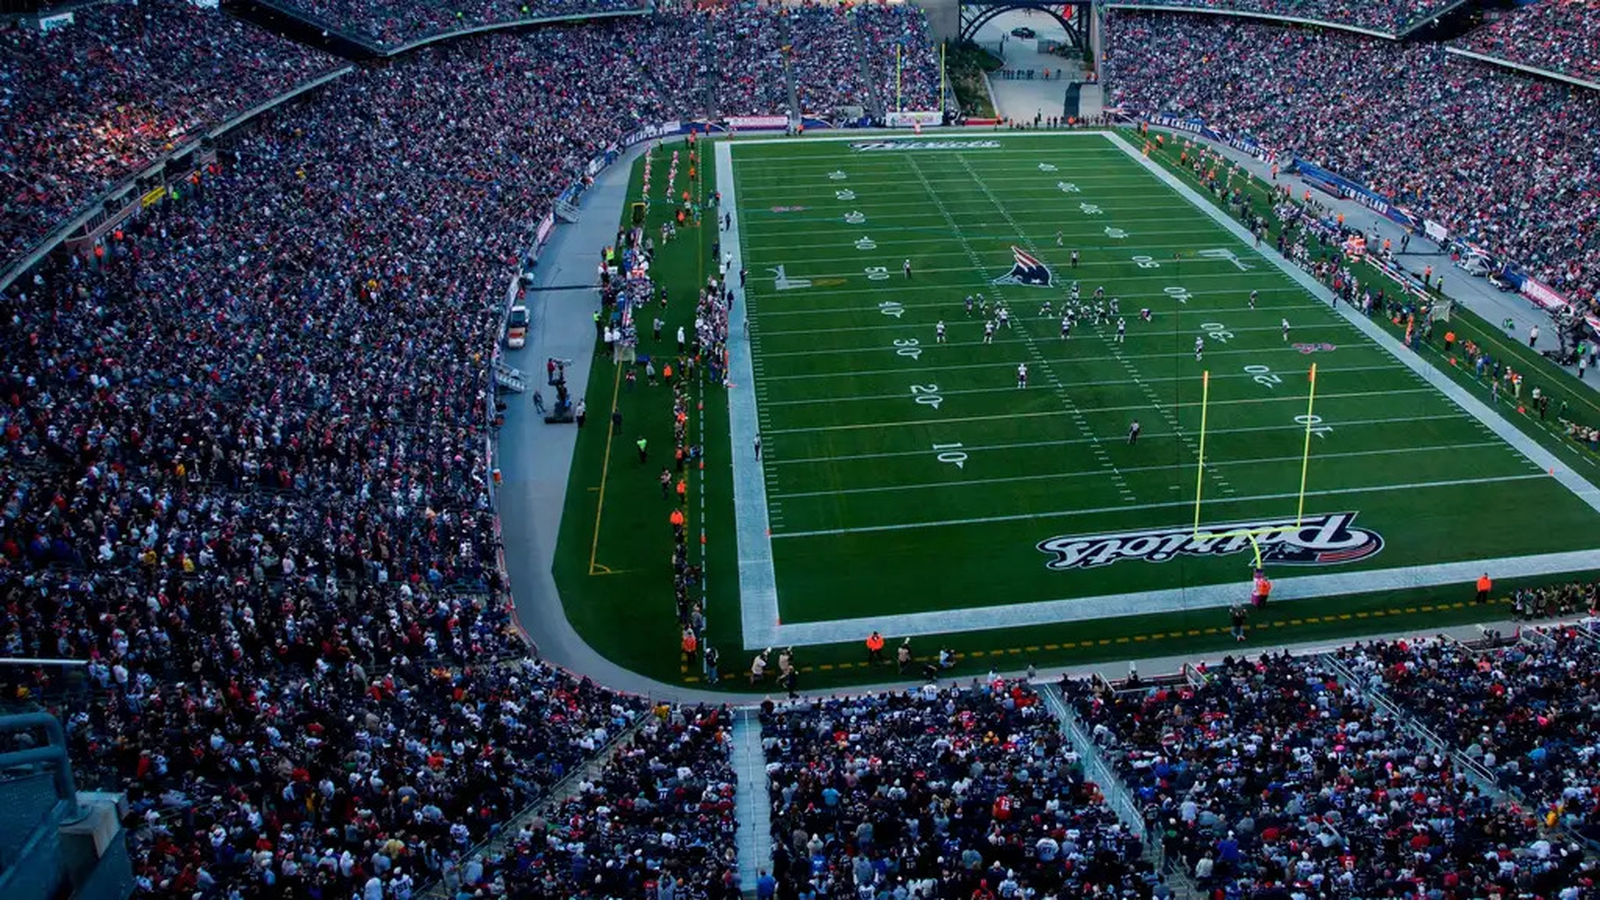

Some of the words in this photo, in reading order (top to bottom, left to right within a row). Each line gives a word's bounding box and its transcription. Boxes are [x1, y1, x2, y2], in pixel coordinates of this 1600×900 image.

[864, 266, 889, 280] 50
[1200, 322, 1235, 341] 30
[893, 338, 922, 357] 30
[1243, 364, 1283, 387] 20
[909, 384, 943, 406] 20
[1293, 414, 1334, 435] 10
[932, 442, 968, 465] 10
[1036, 511, 1385, 570] Patriots
